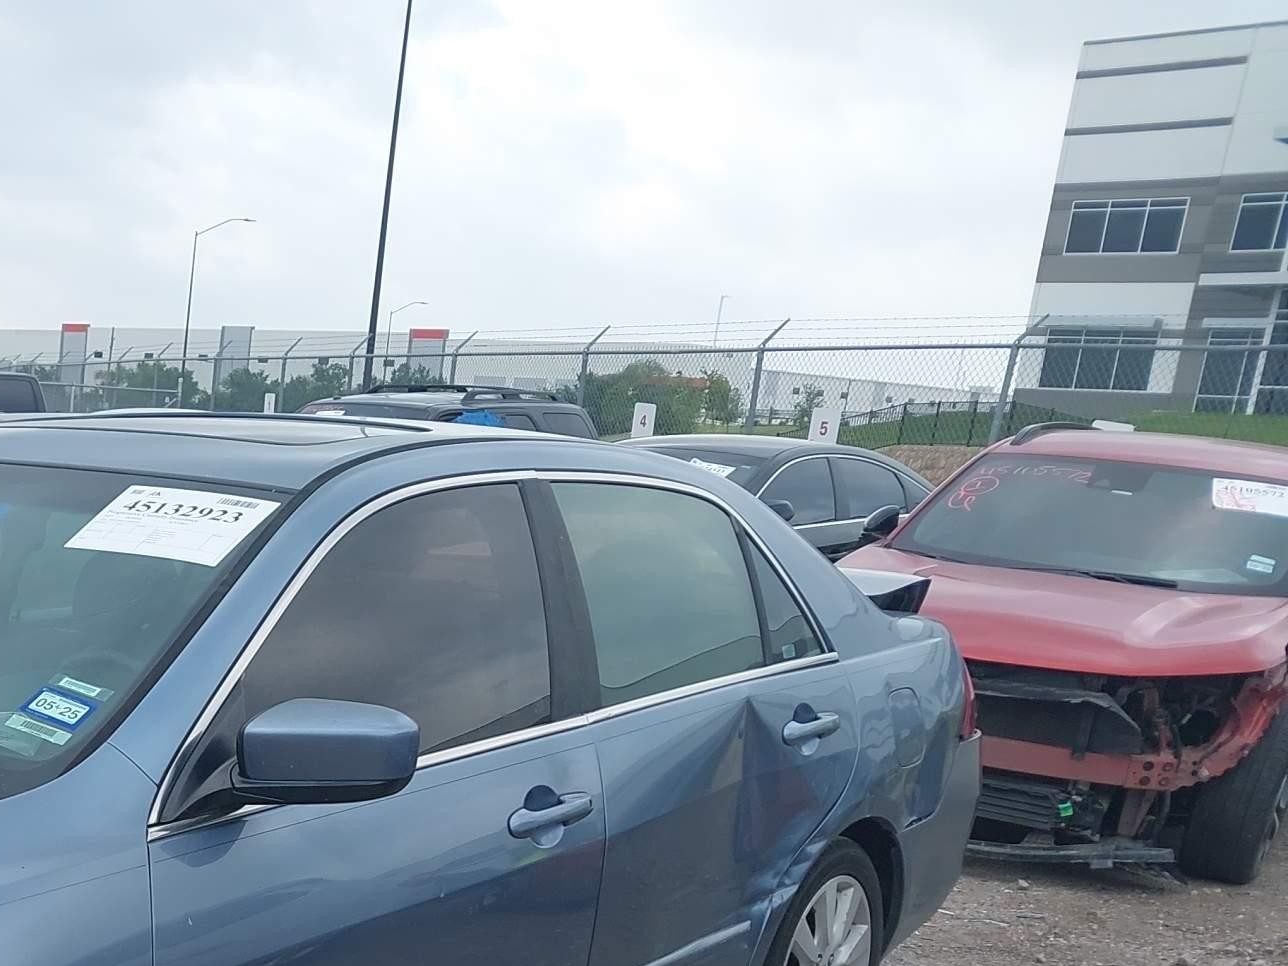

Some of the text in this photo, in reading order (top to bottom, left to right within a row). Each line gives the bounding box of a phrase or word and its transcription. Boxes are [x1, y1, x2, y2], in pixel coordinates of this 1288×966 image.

[639, 414, 648, 428] 4
[819, 421, 829, 436] 5
[123, 500, 244, 524] 45132923
[34, 698, 58, 711] 05
[58, 706, 83, 721] 25
